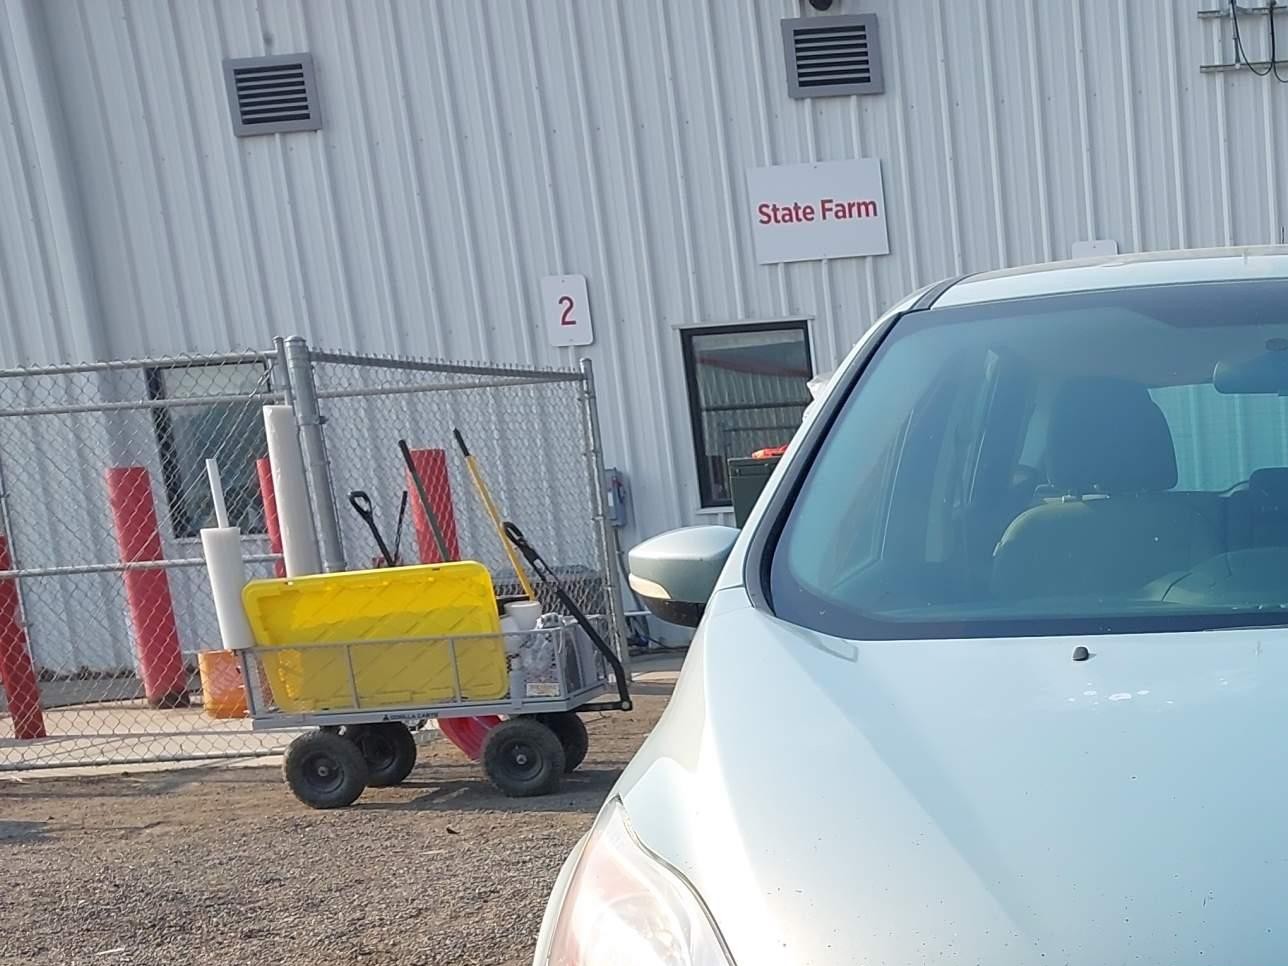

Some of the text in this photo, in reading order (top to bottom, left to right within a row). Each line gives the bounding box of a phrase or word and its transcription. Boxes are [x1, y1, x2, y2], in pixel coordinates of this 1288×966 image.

[758, 199, 878, 225] State Farm
[558, 295, 577, 326] 2
